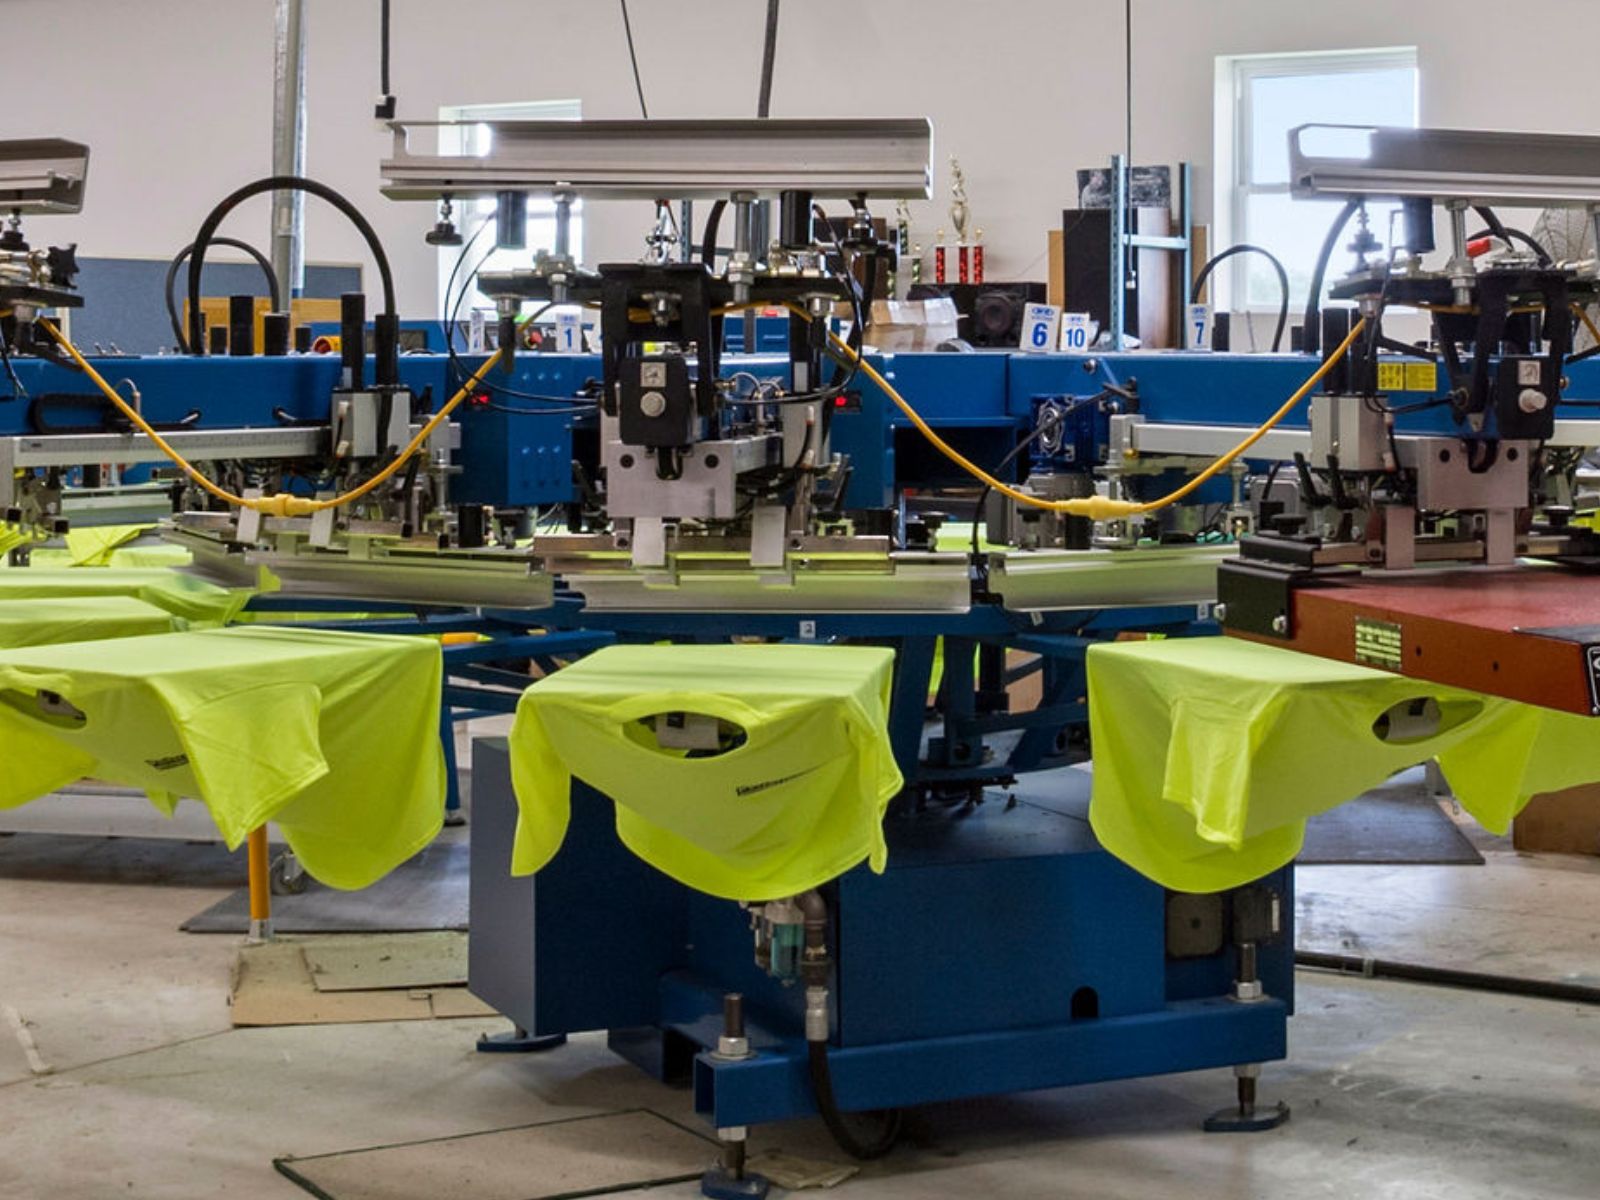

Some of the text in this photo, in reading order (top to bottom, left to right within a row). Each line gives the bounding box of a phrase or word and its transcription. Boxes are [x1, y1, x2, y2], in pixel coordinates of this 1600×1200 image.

[564, 327, 572, 348] 1
[1032, 322, 1048, 347] 6
[1066, 328, 1085, 347] 10
[1195, 321, 1204, 344] 7
